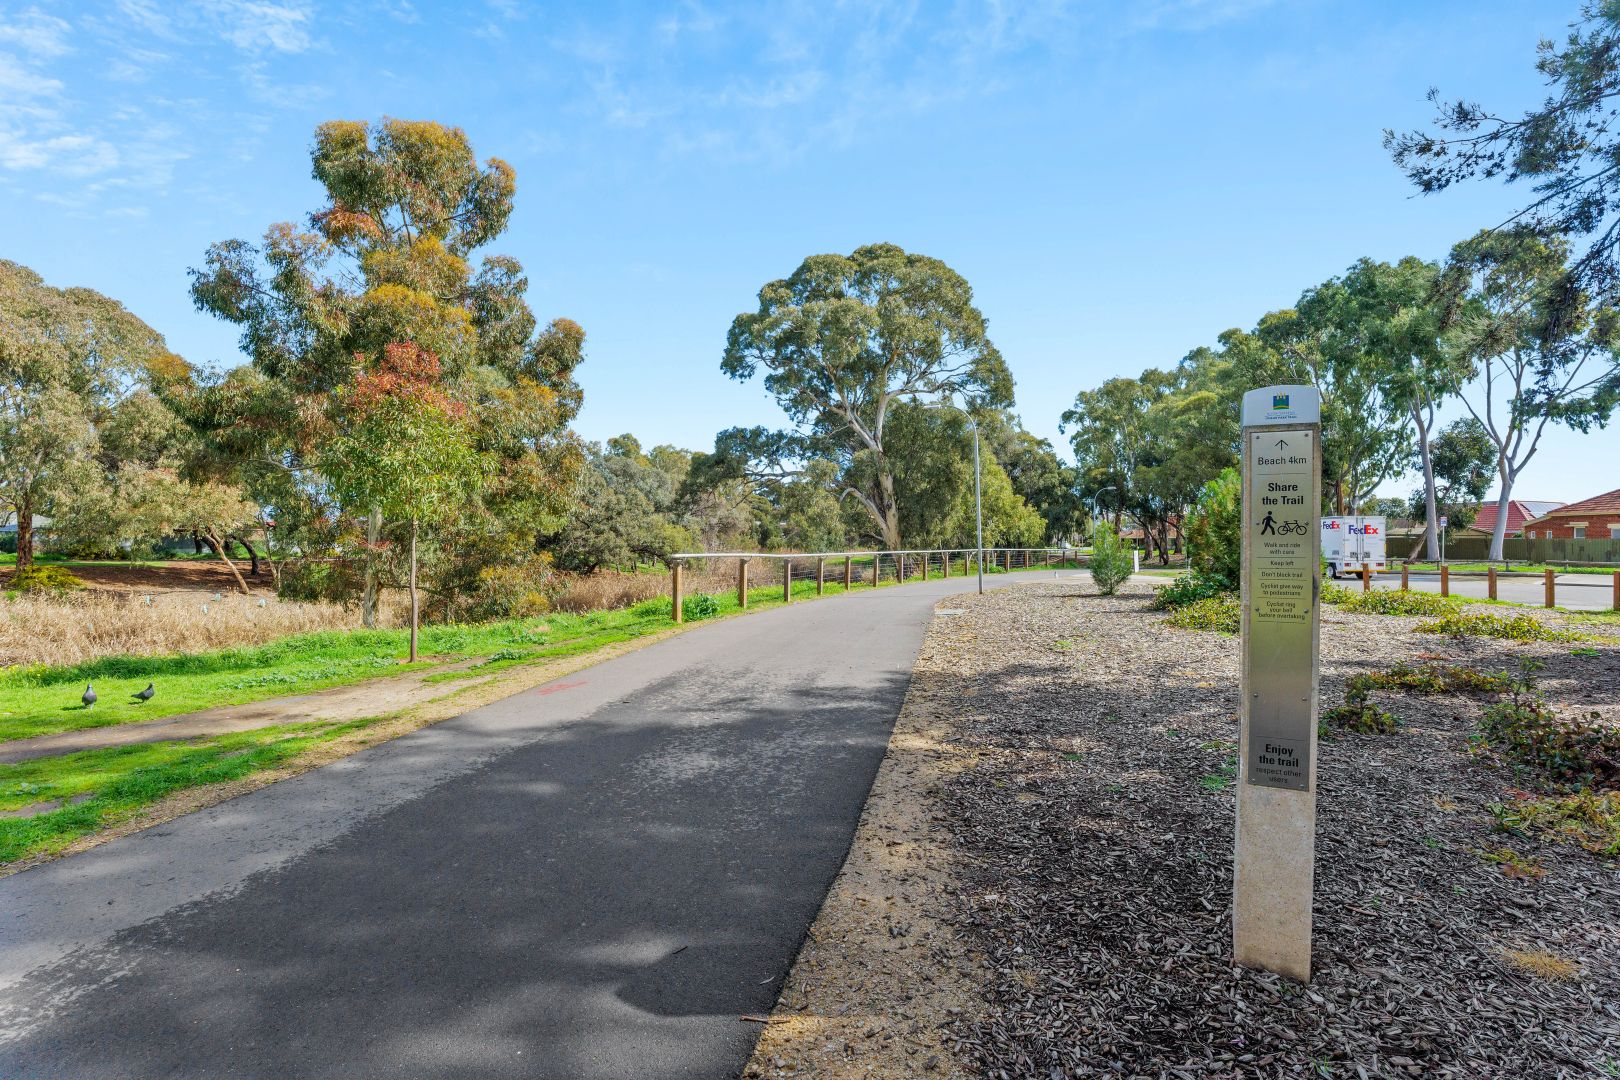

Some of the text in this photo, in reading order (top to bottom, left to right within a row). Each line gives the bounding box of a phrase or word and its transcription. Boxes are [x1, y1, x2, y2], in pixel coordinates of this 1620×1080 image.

[1258, 456, 1306, 466] Beach 4km
[1268, 482, 1298, 492] Share
[1262, 496, 1304, 506] the Trail
[1322, 520, 1340, 530] FedEx
[1348, 524, 1378, 534] FedEx
[1265, 743, 1293, 757] Enjoy
[1259, 754, 1298, 767] the trail
